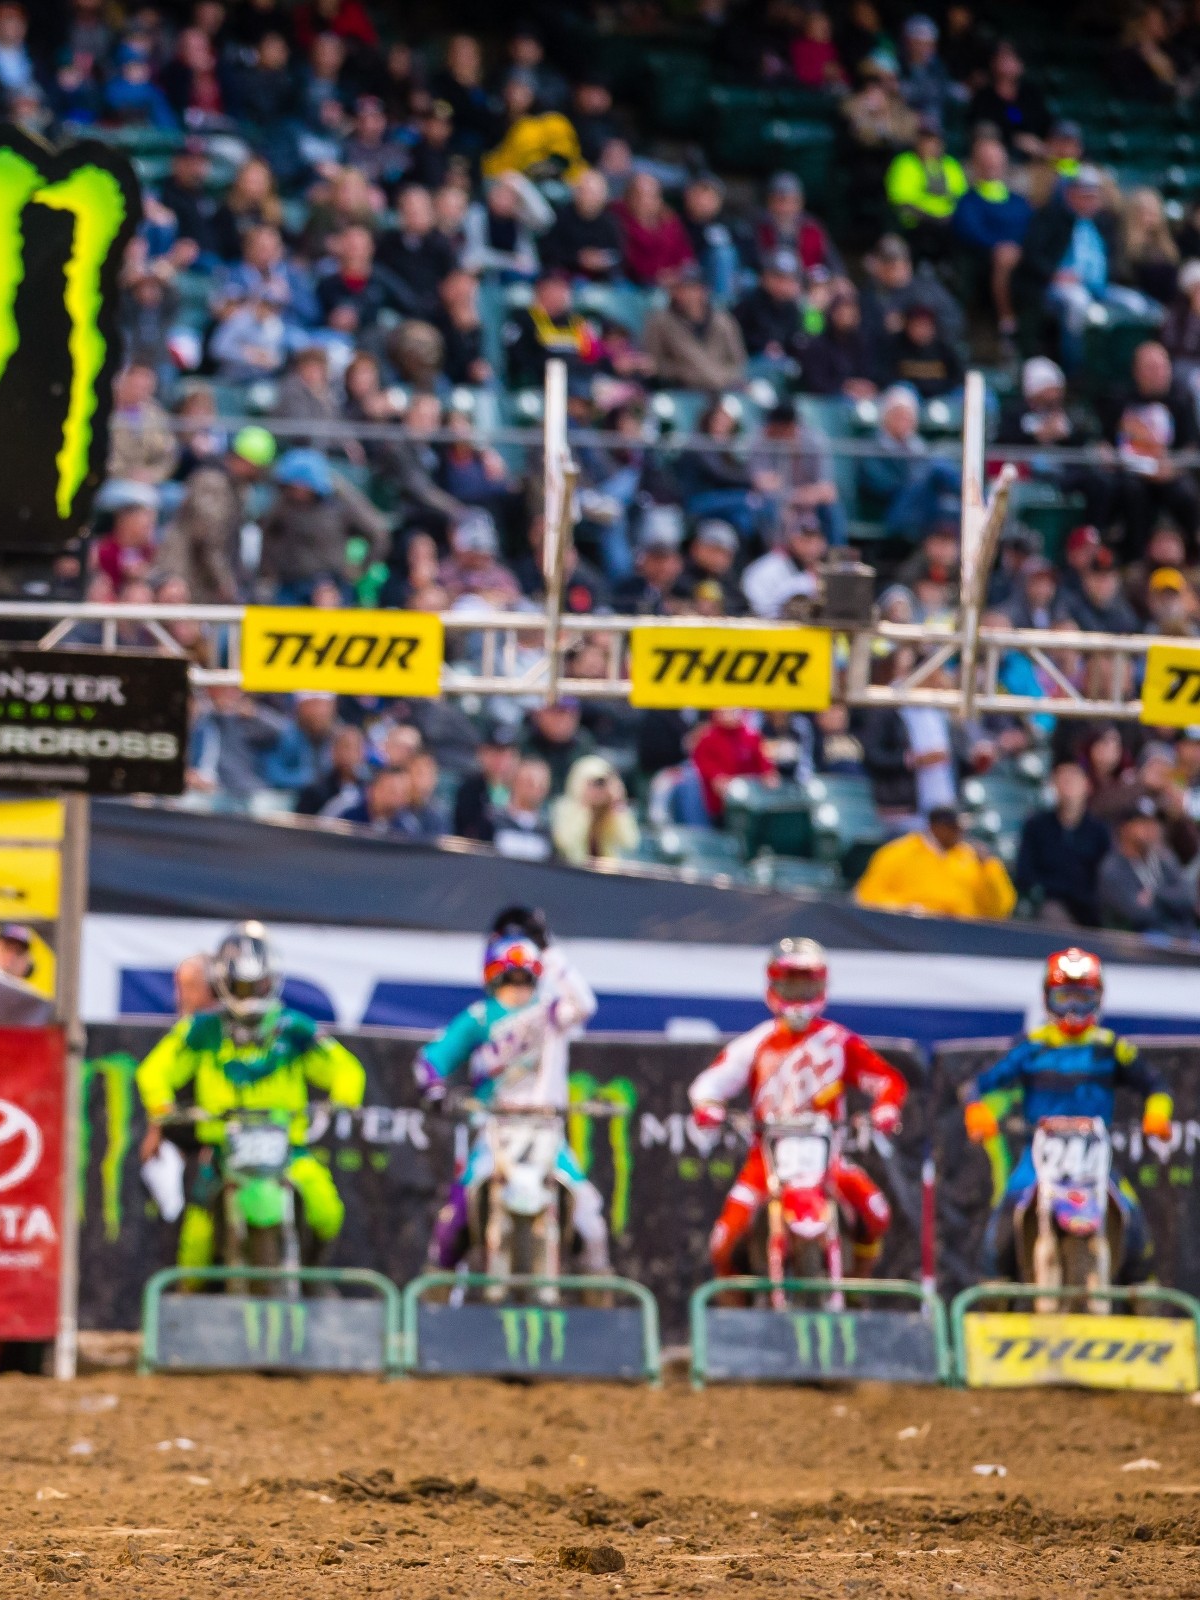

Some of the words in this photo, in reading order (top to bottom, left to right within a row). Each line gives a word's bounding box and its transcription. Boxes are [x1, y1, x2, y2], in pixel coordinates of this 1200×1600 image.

[263, 631, 421, 672] THOR
[651, 647, 810, 688] THOR
[988, 1336, 1174, 1365] THOR
